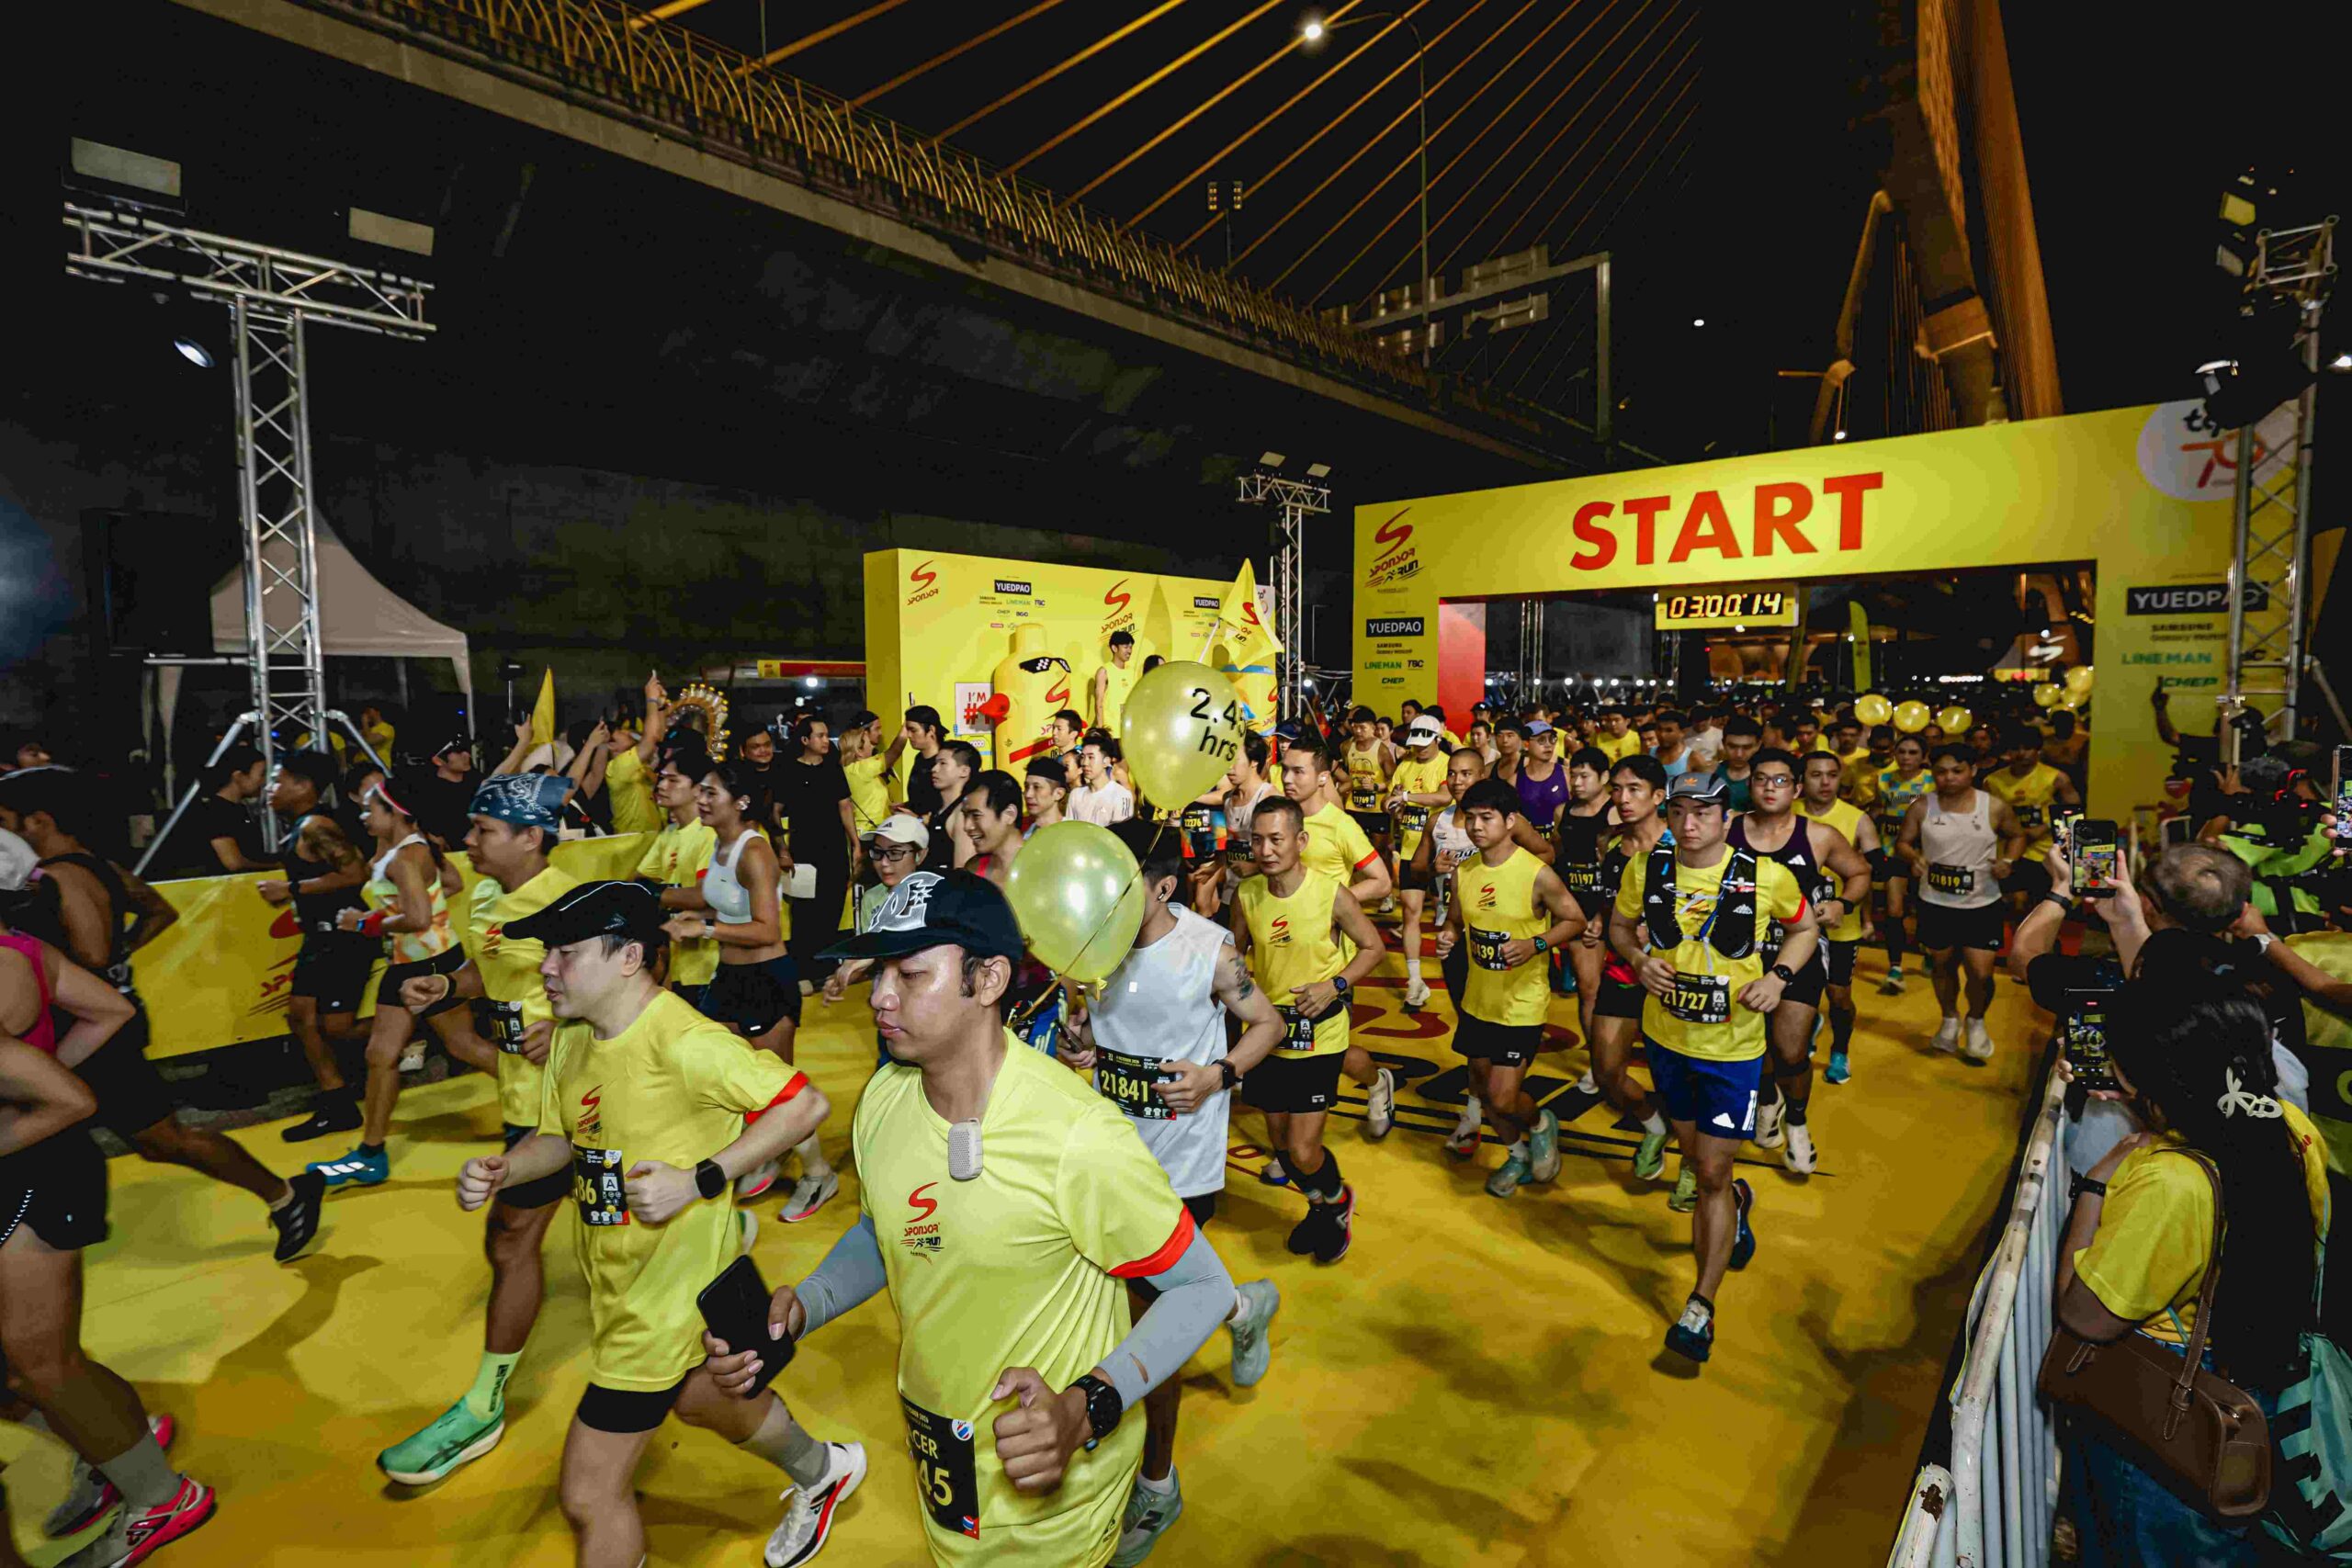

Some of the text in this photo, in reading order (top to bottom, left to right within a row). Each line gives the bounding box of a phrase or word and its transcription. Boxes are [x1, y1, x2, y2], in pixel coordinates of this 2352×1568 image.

[1569, 471, 1883, 570] START
[1369, 547, 1416, 578] SPONSOR
[1397, 559, 1419, 575] RUN
[996, 581, 1031, 593] YUEDPAO
[907, 588, 939, 605] SPONSOR
[1195, 599, 1219, 607] YUEDPAO
[1101, 612, 1133, 634] SPONSOR
[1369, 621, 1421, 634] YUEDPAO
[967, 692, 987, 703] I'M
[1199, 726, 1238, 761] hrs
[1664, 988, 1709, 1010] 21727
[1101, 1069, 1148, 1102] 21841
[605, 1179, 616, 1189] A
[904, 1224, 940, 1237] SPONSOR
[926, 1236, 941, 1246] RUN
[911, 1429, 938, 1459] CER
[920, 1459, 953, 1506] 45
